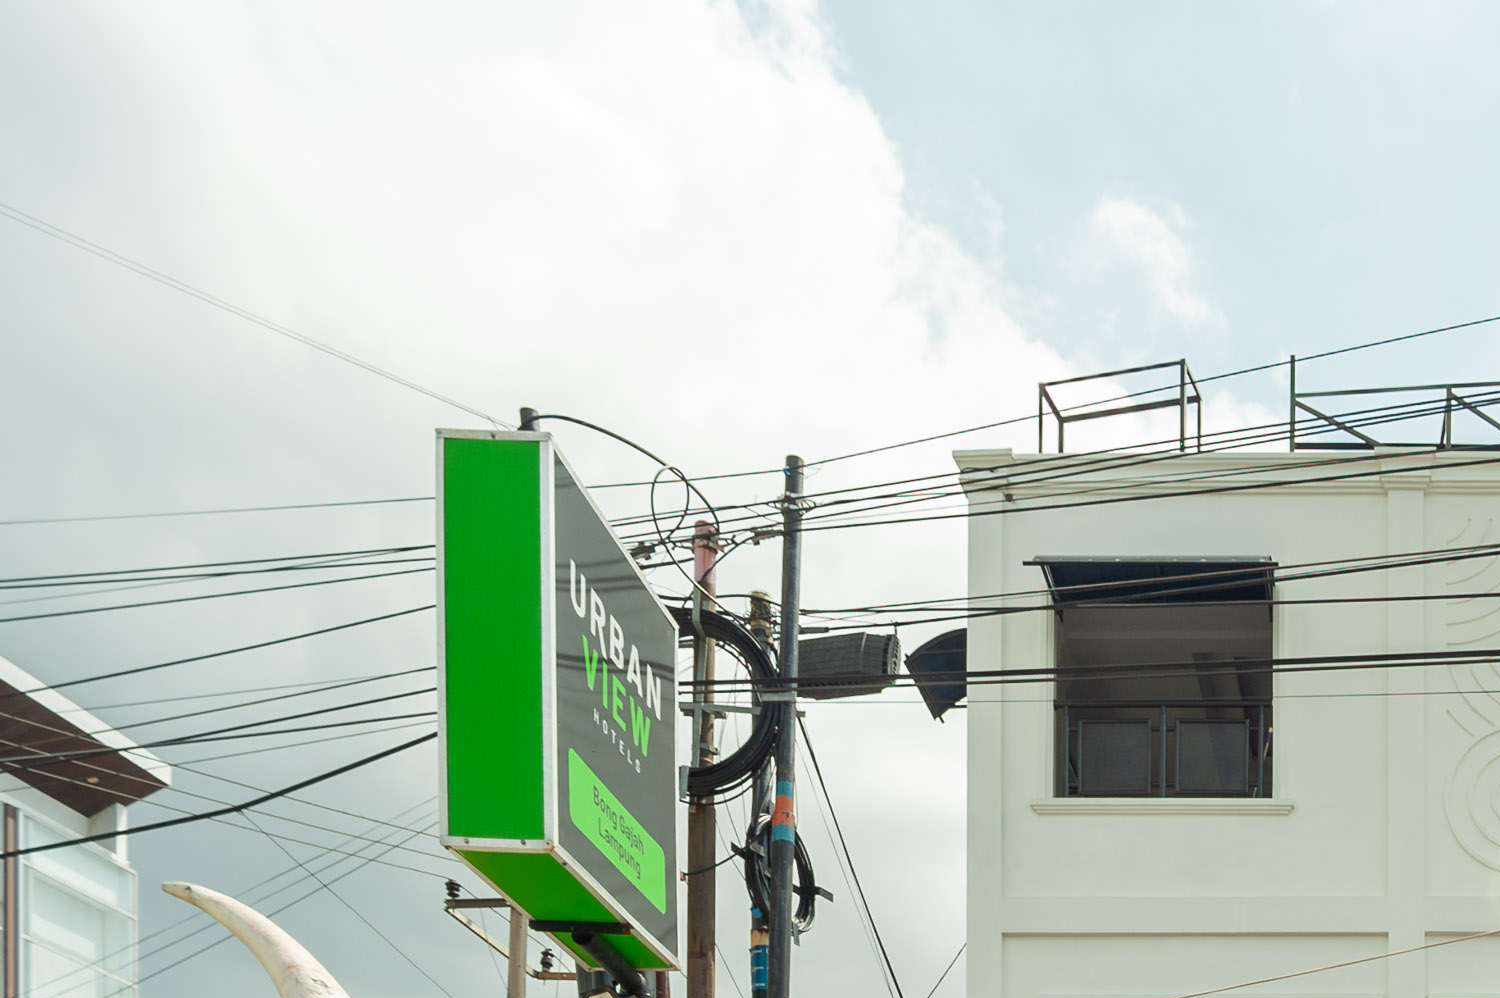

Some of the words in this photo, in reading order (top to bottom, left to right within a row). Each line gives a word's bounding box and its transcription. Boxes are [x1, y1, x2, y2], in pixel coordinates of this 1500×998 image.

[570, 557, 662, 721] URBAN
[582, 634, 651, 757] VIEW
[593, 708, 641, 774] HOTELS
[592, 785, 618, 834] Bong
[619, 814, 645, 855] Gajah
[598, 817, 642, 880] Lampung
